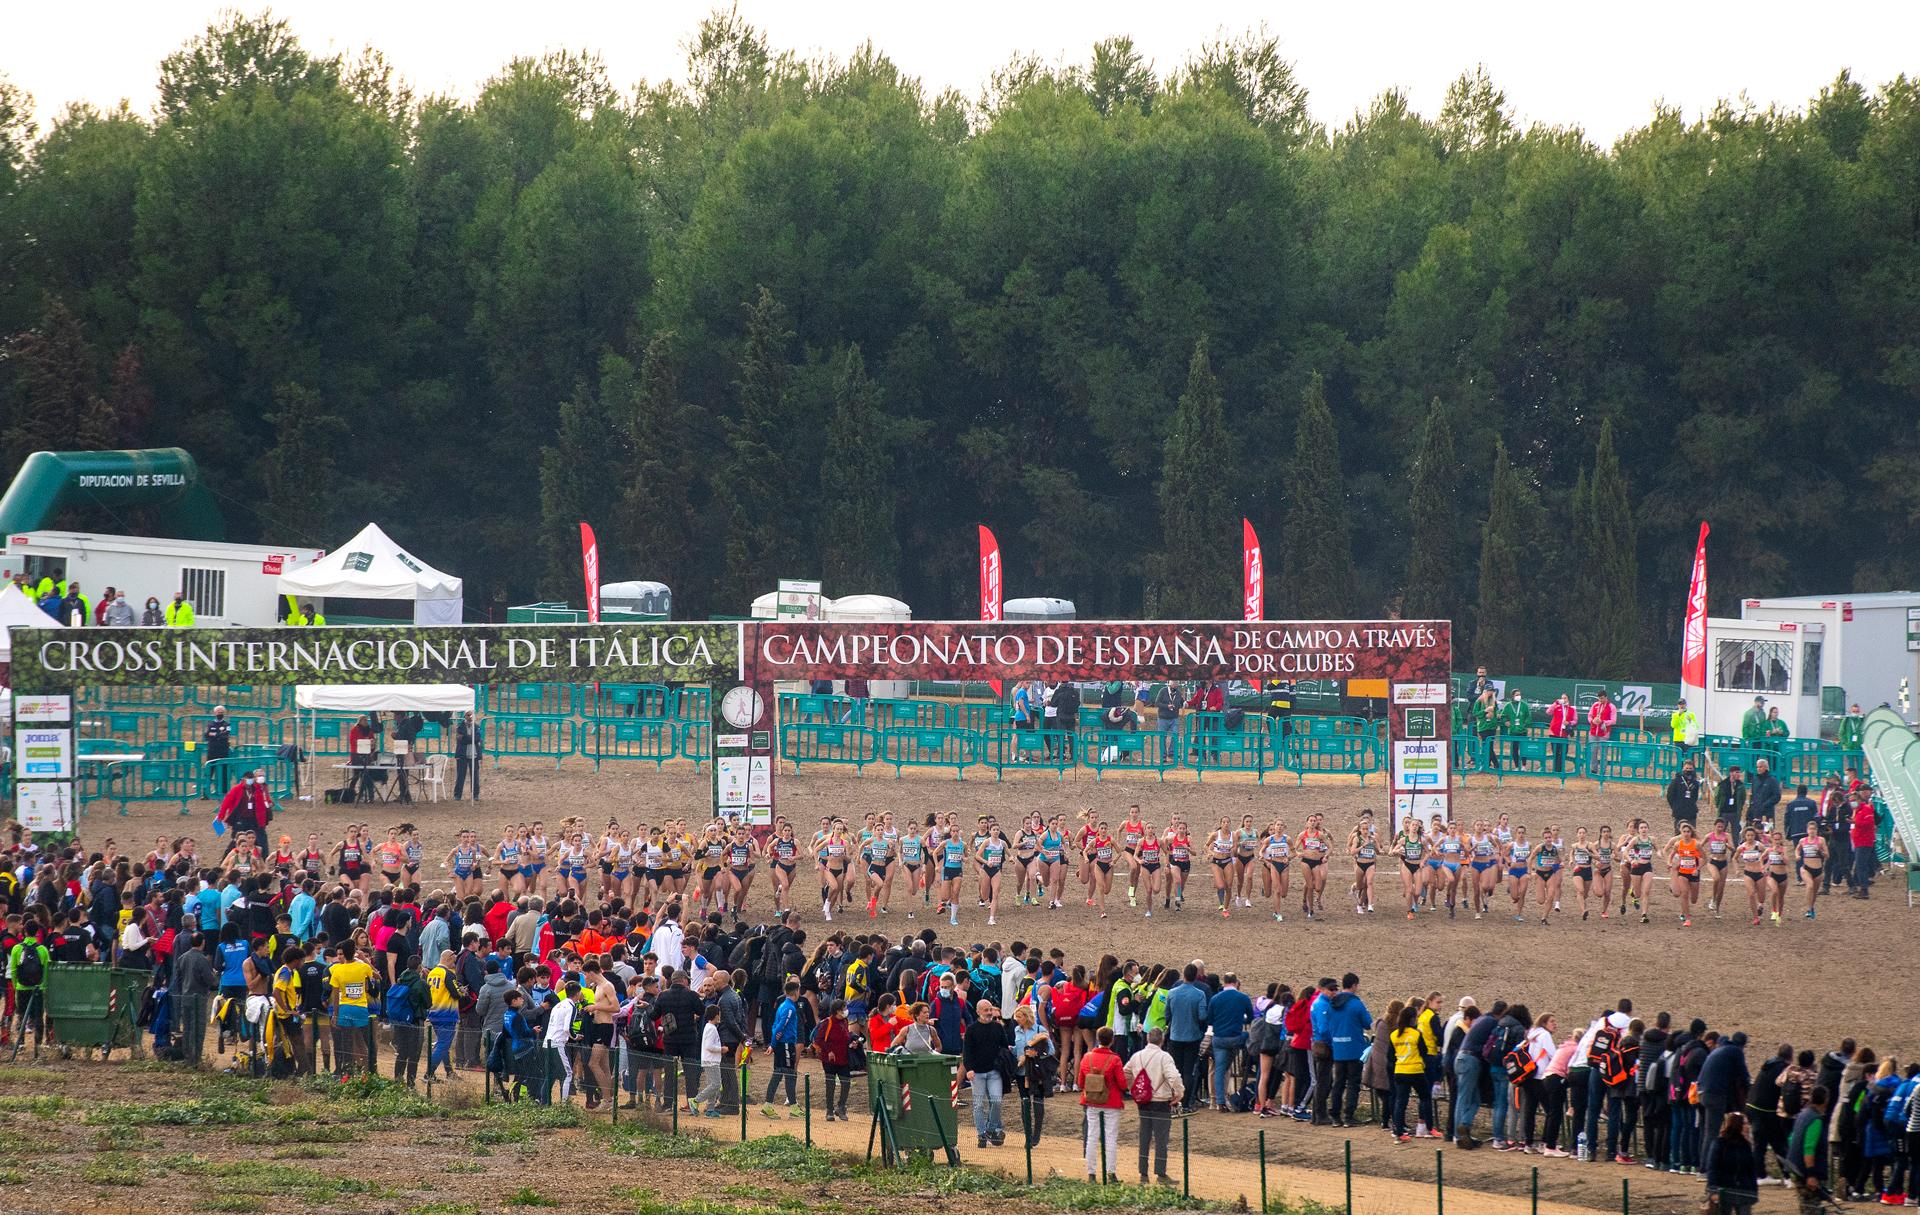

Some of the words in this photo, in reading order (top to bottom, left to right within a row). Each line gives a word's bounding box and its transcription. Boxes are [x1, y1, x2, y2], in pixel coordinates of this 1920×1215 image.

[79, 475, 133, 487] DIPUTACION
[137, 475, 149, 487] DE
[152, 474, 185, 486] SEVILLA
[762, 634, 1026, 665] CAMPEONATO
[1034, 635, 1084, 665] DE
[1094, 628, 1229, 666] ESPAÑA
[1233, 630, 1262, 649] DE
[1266, 629, 1343, 649] CAMPO
[1345, 630, 1361, 648] A
[1363, 624, 1437, 648] TRAVÉS
[41, 640, 163, 671] CROSS
[175, 639, 497, 671] INTERNACIONAL
[507, 638, 557, 669] DE
[568, 629, 717, 668] ITÁLICA
[1234, 653, 1278, 673] POR
[1281, 652, 1355, 672] CLUBES
